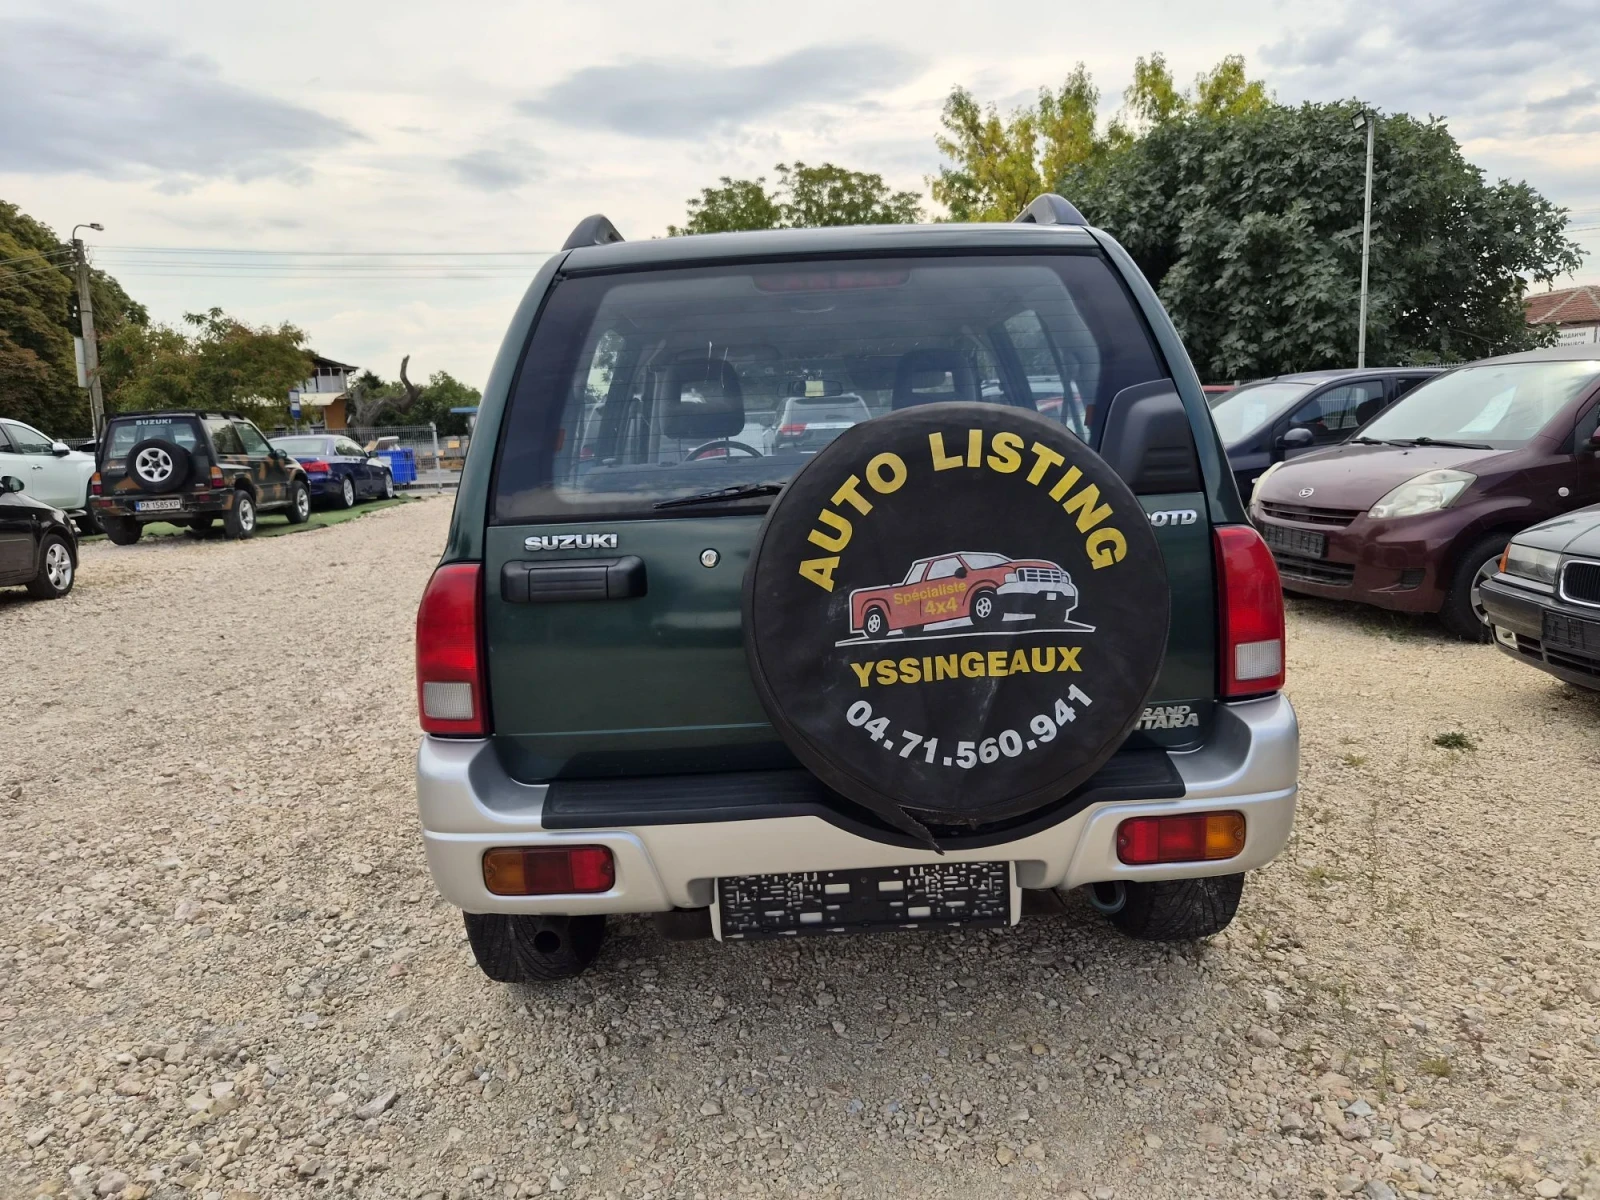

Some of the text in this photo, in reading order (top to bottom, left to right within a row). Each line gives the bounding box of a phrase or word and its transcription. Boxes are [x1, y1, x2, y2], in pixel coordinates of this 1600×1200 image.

[135, 418, 172, 426] SUZUKI
[799, 430, 1128, 592] AUTO LISTING
[524, 533, 618, 551] SUZUKI
[893, 582, 967, 605] Spécialiste
[925, 597, 958, 615] 4x4
[850, 646, 1083, 688] YSSINGEAUX
[1140, 705, 1191, 718] RAND
[845, 683, 1093, 769] 04.71.560.941
